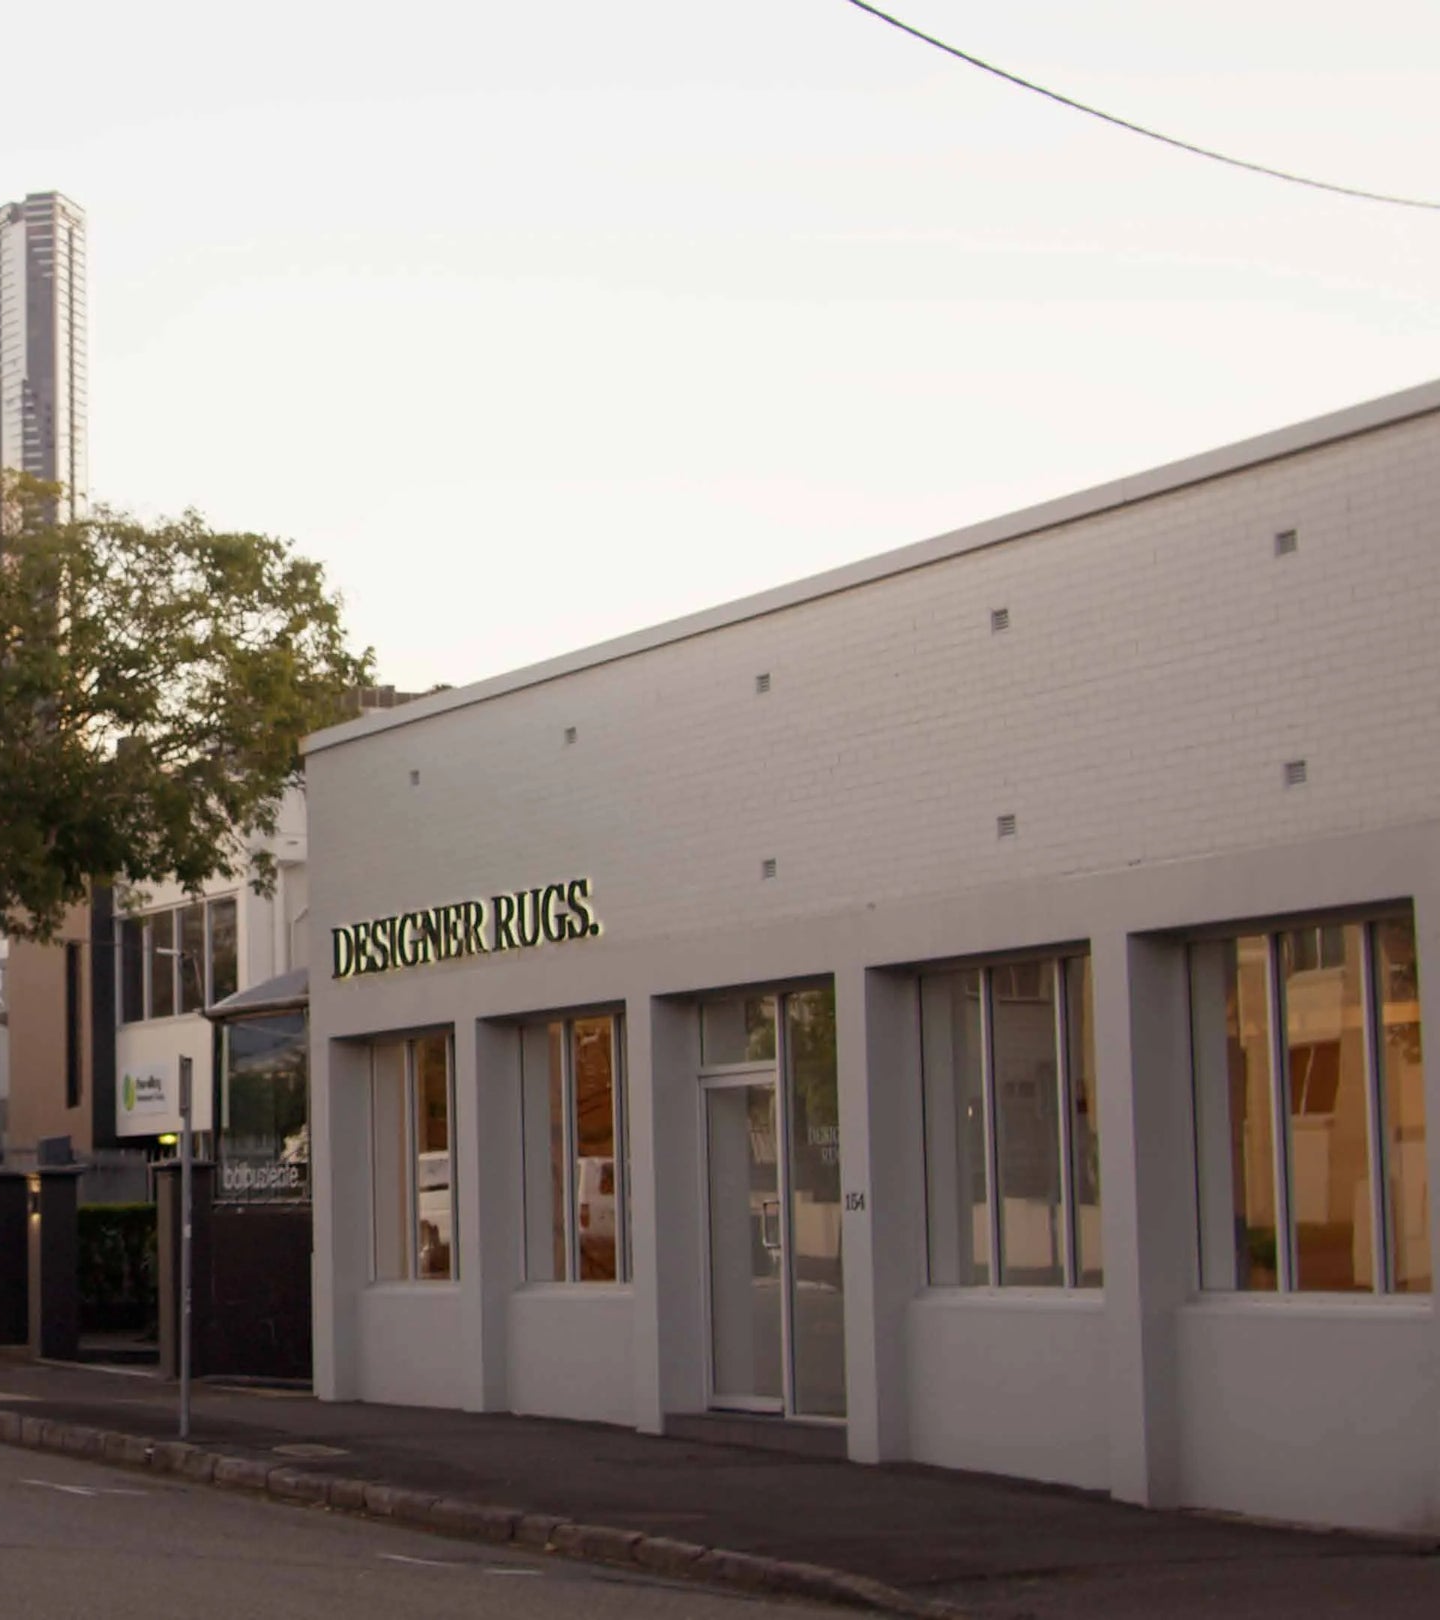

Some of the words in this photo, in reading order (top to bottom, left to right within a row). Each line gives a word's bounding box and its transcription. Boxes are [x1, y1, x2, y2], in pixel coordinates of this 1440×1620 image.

[331, 900, 489, 979] DESIGNER
[491, 878, 601, 952] RUGS.
[845, 1193, 865, 1211] 154
